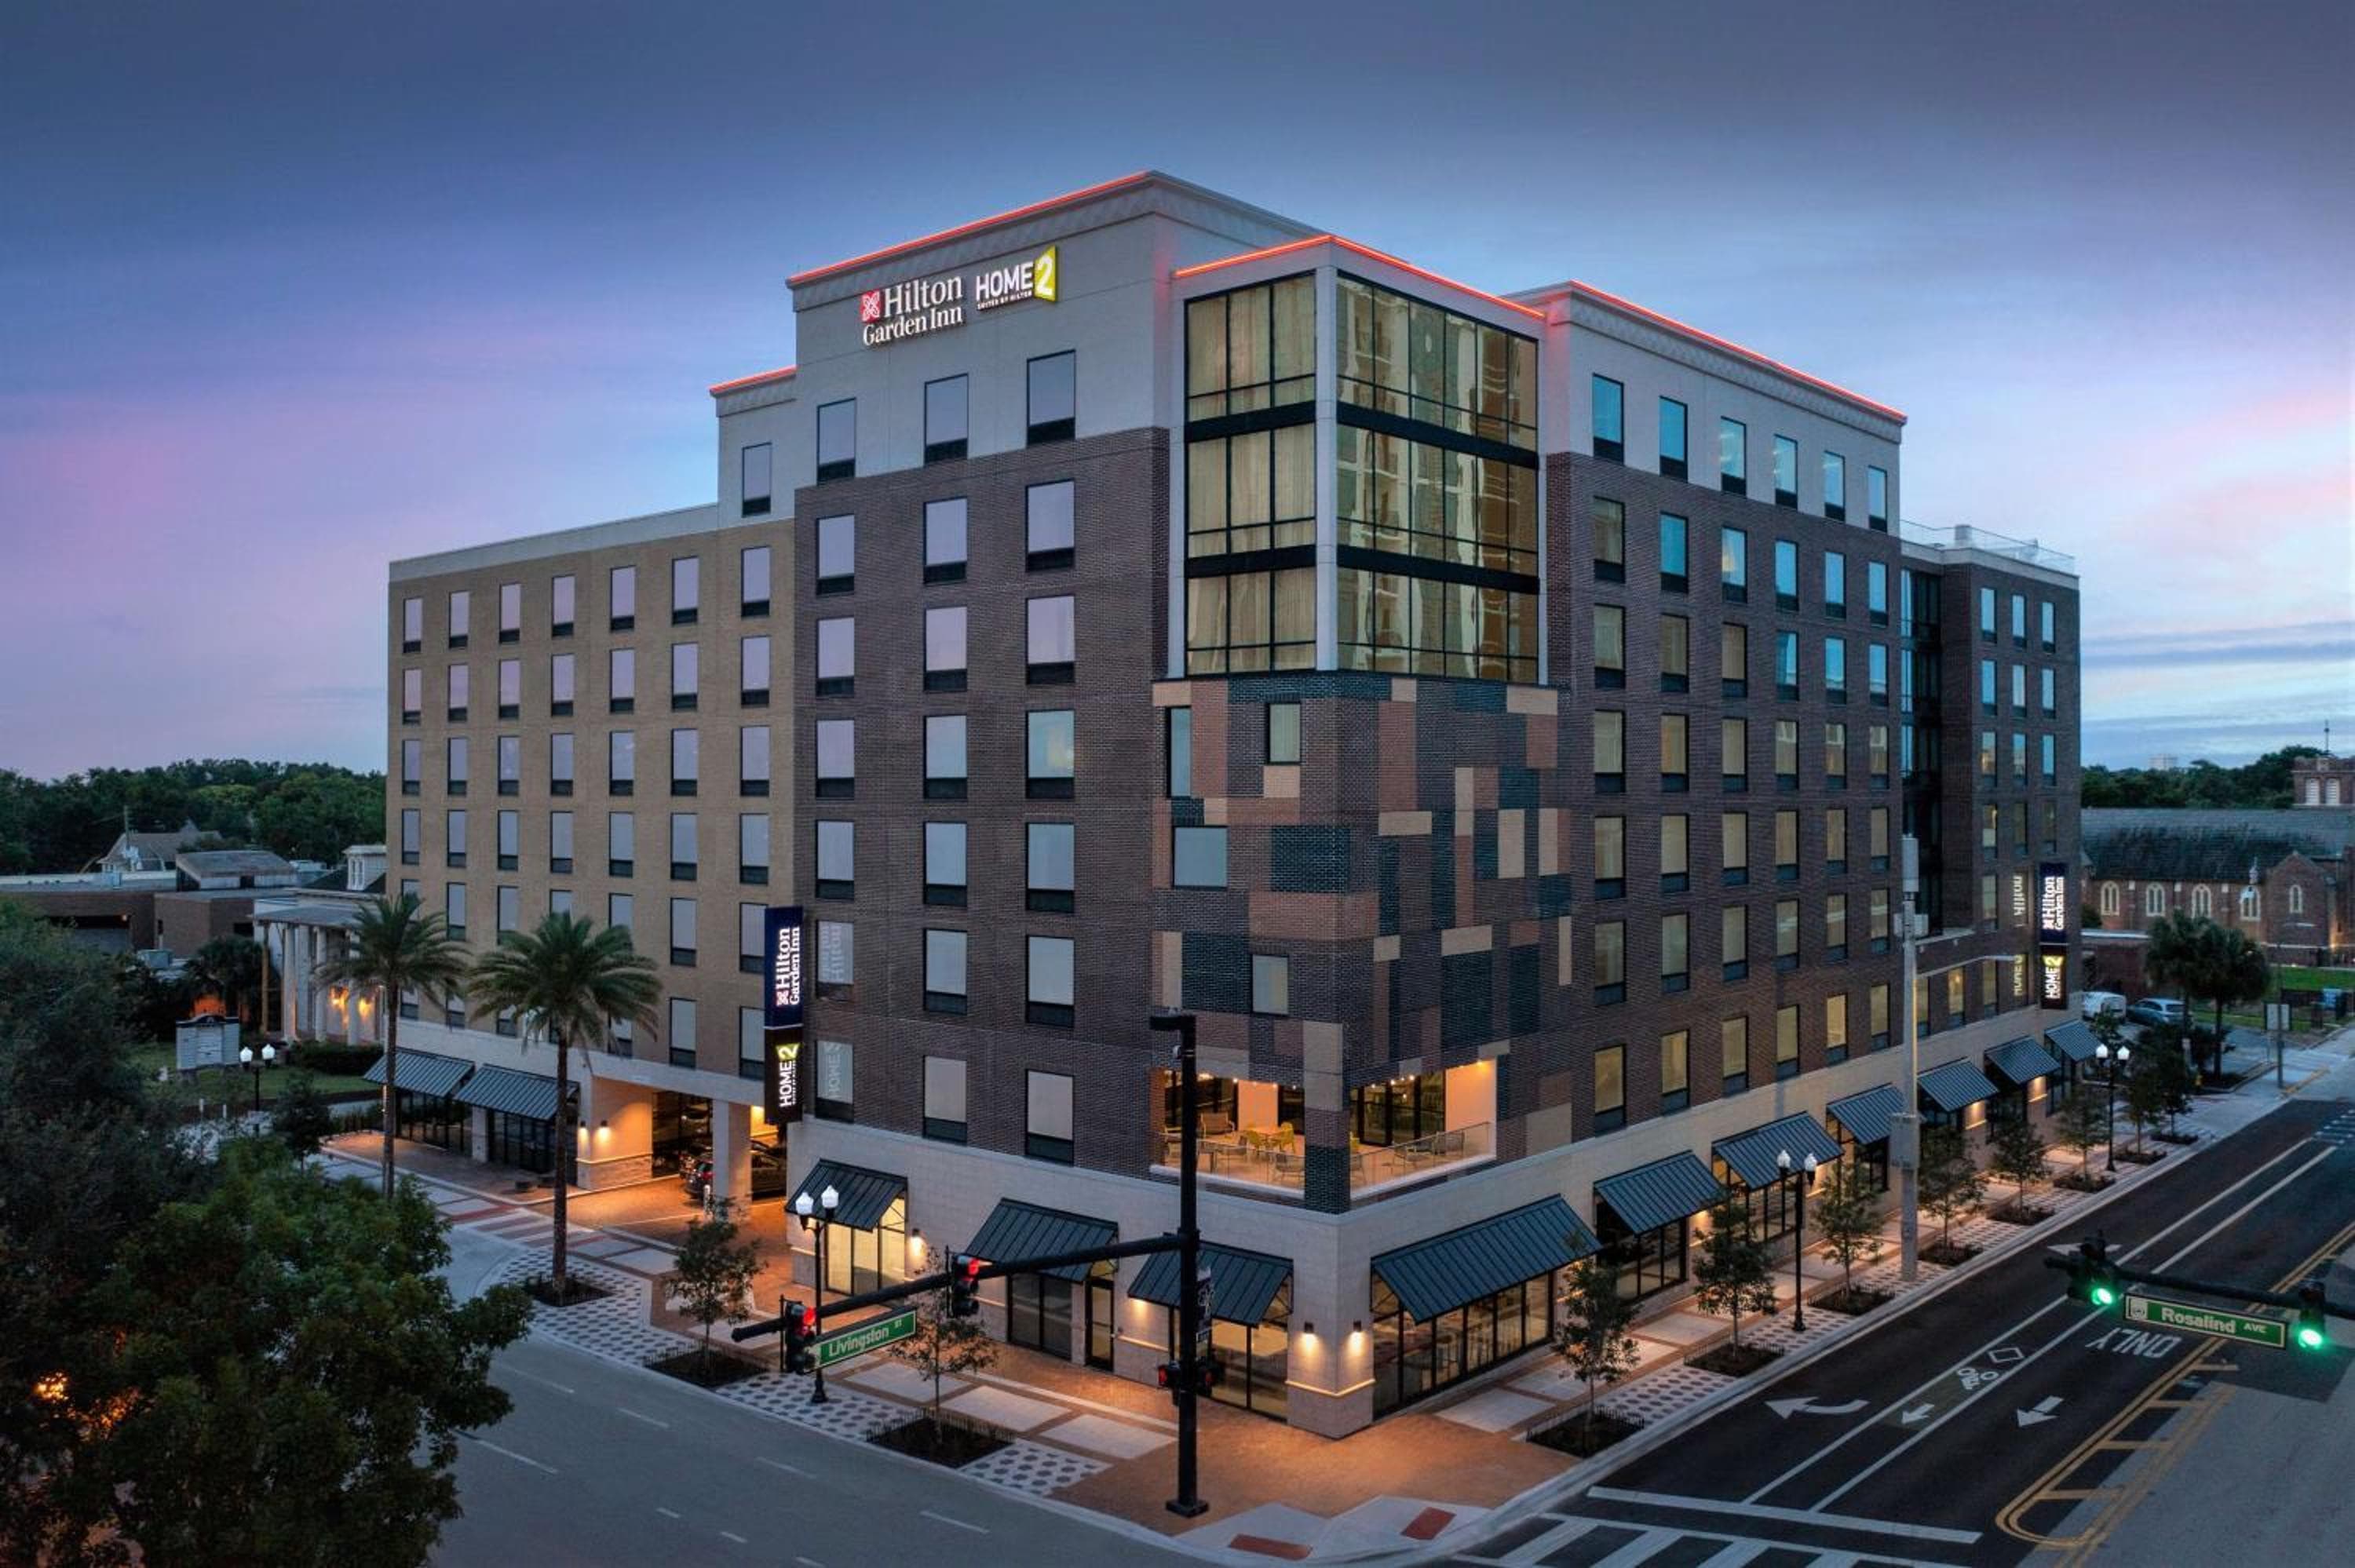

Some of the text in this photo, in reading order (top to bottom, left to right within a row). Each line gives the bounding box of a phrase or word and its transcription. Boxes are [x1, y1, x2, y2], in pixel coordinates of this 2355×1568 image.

[884, 276, 963, 318] Hilton
[864, 306, 962, 346] Garden Inn
[2042, 876, 2055, 917] Hilton
[776, 928, 790, 990] Hilton
[789, 927, 800, 1005] Garden Inn
[2161, 1307, 2266, 1334] Rosalind AVE
[828, 1326, 889, 1356] Livingston
[2085, 1326, 2183, 1358] ONLY
